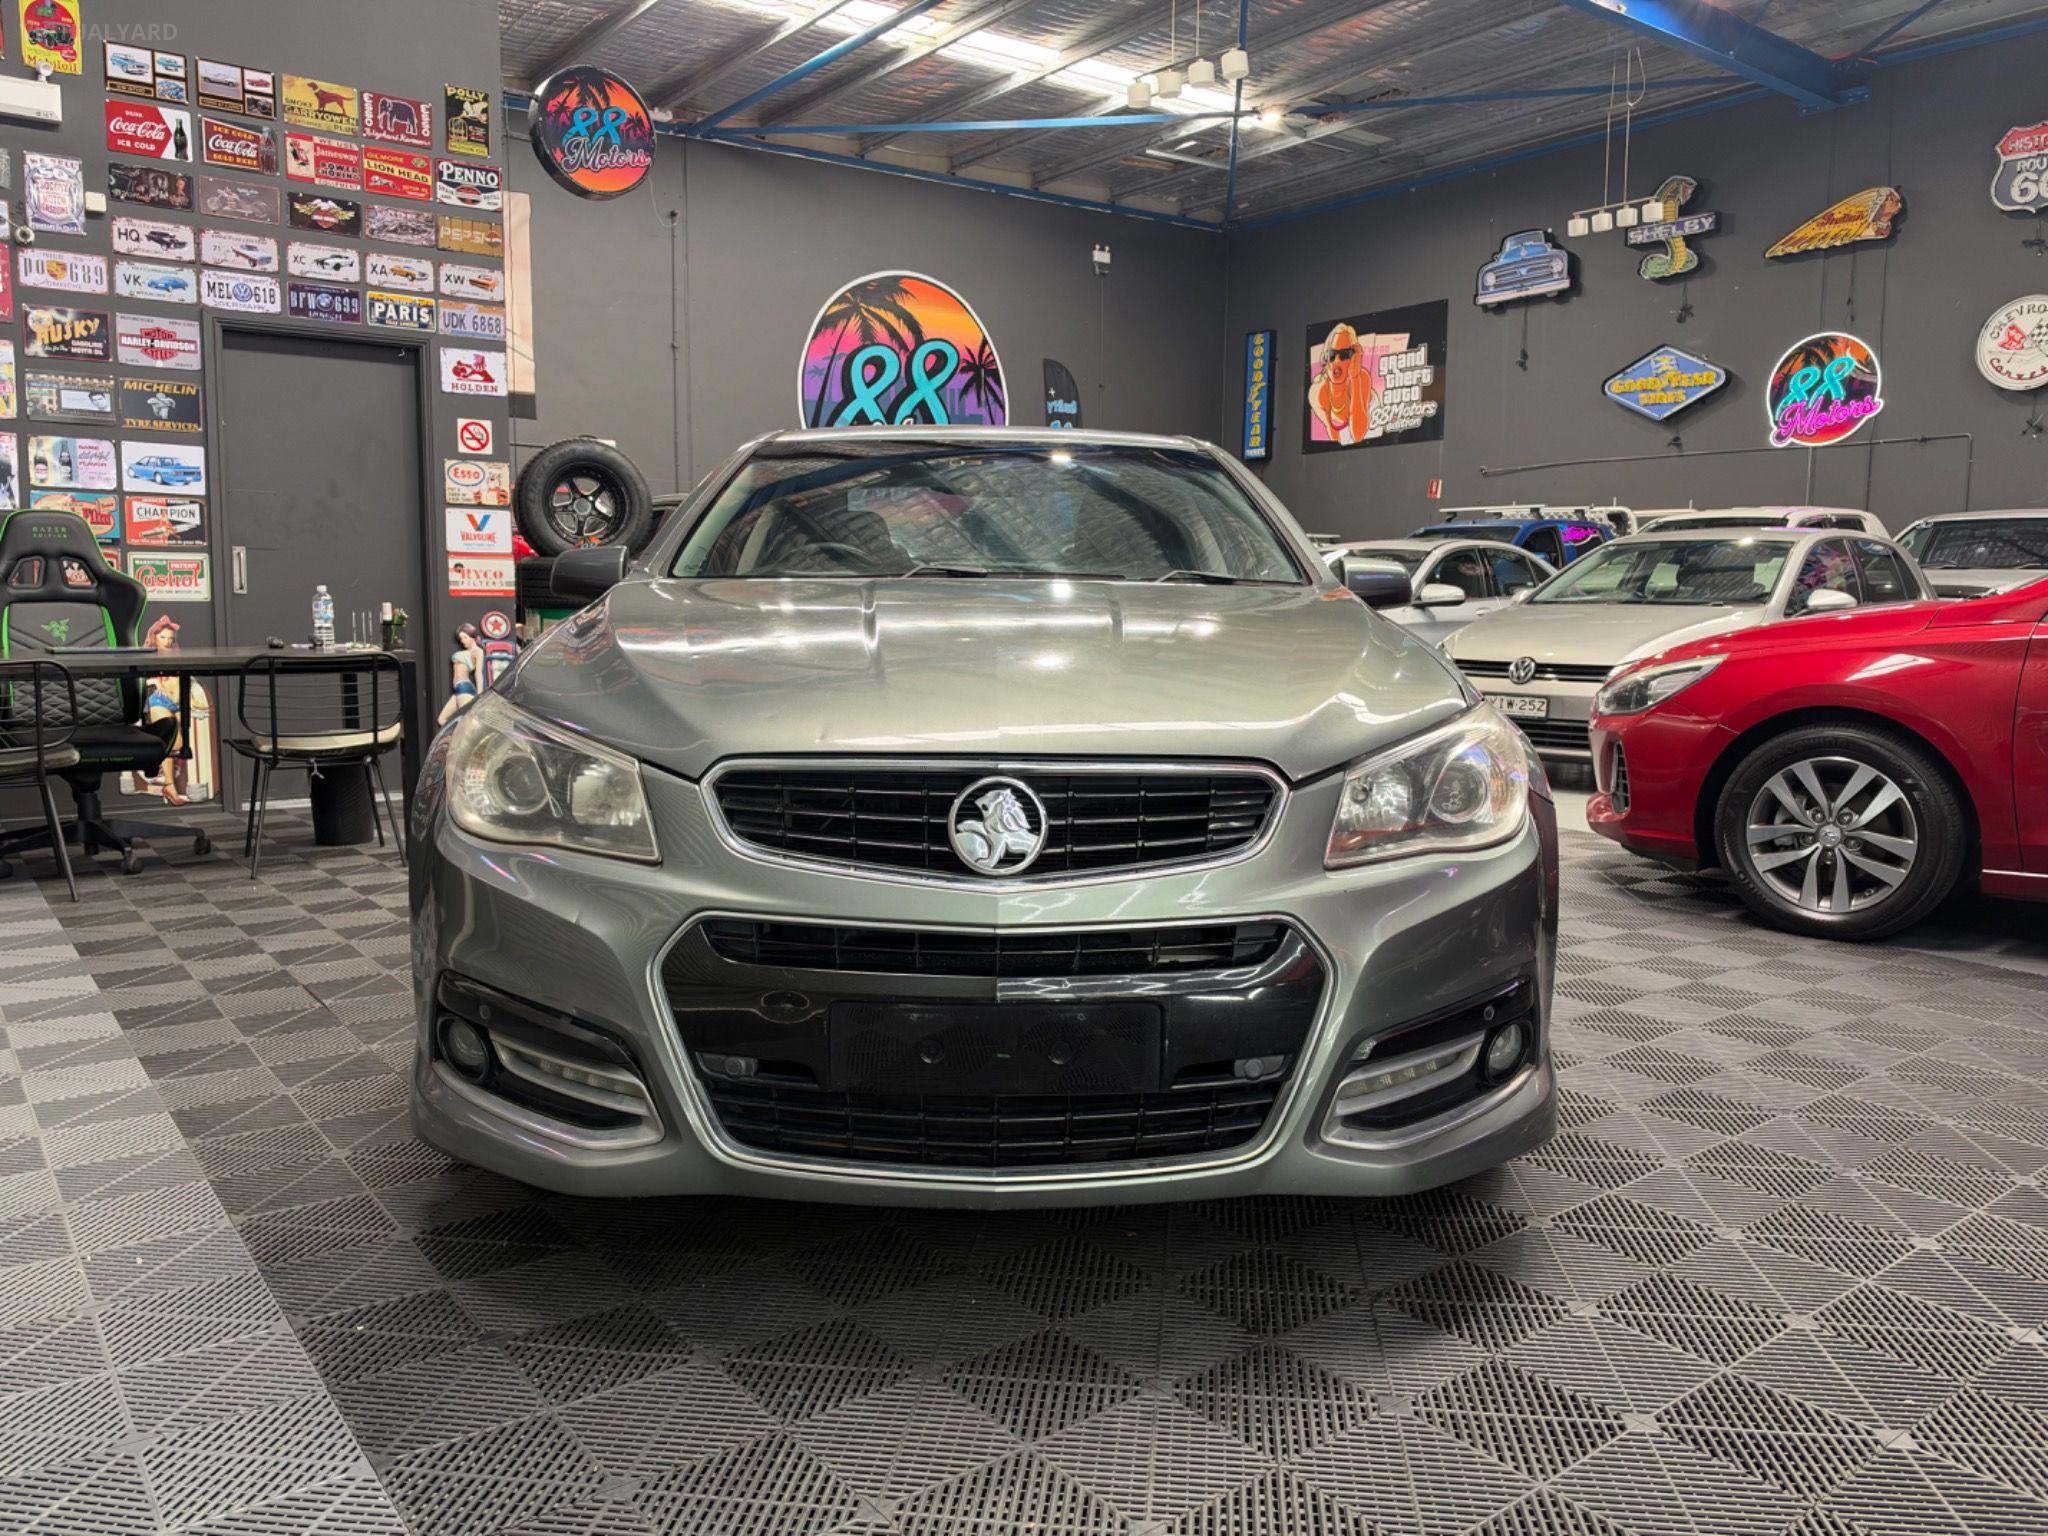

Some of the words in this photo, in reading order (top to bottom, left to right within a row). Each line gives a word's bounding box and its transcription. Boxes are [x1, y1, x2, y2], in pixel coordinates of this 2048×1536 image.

[446, 85, 485, 100] POLLY
[125, 110, 143, 118] DRINK
[109, 117, 165, 141] Coca-Cola
[213, 125, 229, 133] ICE
[232, 129, 255, 140] COLD
[562, 106, 627, 145] 88
[117, 139, 132, 148] ICE
[134, 141, 156, 151] COLD
[209, 135, 258, 157] Coca-Cola
[562, 136, 651, 172] Motors
[366, 152, 404, 164] GILMORE
[366, 161, 394, 174] LION
[398, 168, 429, 183] HEAD
[439, 162, 499, 187] PENNO
[118, 228, 140, 242] HQ
[441, 226, 484, 245] PEPSI
[1629, 214, 1716, 245] SHELBY
[293, 255, 306, 265] XC
[70, 262, 104, 285] 689
[370, 264, 388, 276] XA
[444, 273, 465, 285] XW
[123, 274, 142, 286] VK
[207, 281, 232, 299] MEL
[335, 294, 359, 314] 699
[375, 301, 430, 323] PARIS
[443, 310, 466, 330] UDK
[472, 314, 502, 335] 6868
[121, 336, 196, 351] HARLEY-DAVIDSON
[1380, 346, 1426, 375] grand
[123, 379, 197, 396] MICHELIN
[451, 382, 498, 393] HOLDEN
[1386, 368, 1430, 389] theft
[1609, 370, 1716, 394] GOODYEAR
[1775, 355, 1856, 420] 88
[1383, 385, 1420, 405] auto
[125, 418, 151, 429] TYRE
[153, 419, 199, 432] SERVICES
[1771, 394, 1880, 444] Motors
[460, 531, 496, 544] VALVOLINE
[136, 561, 200, 588] Castrol
[171, 562, 197, 570] PATENT
